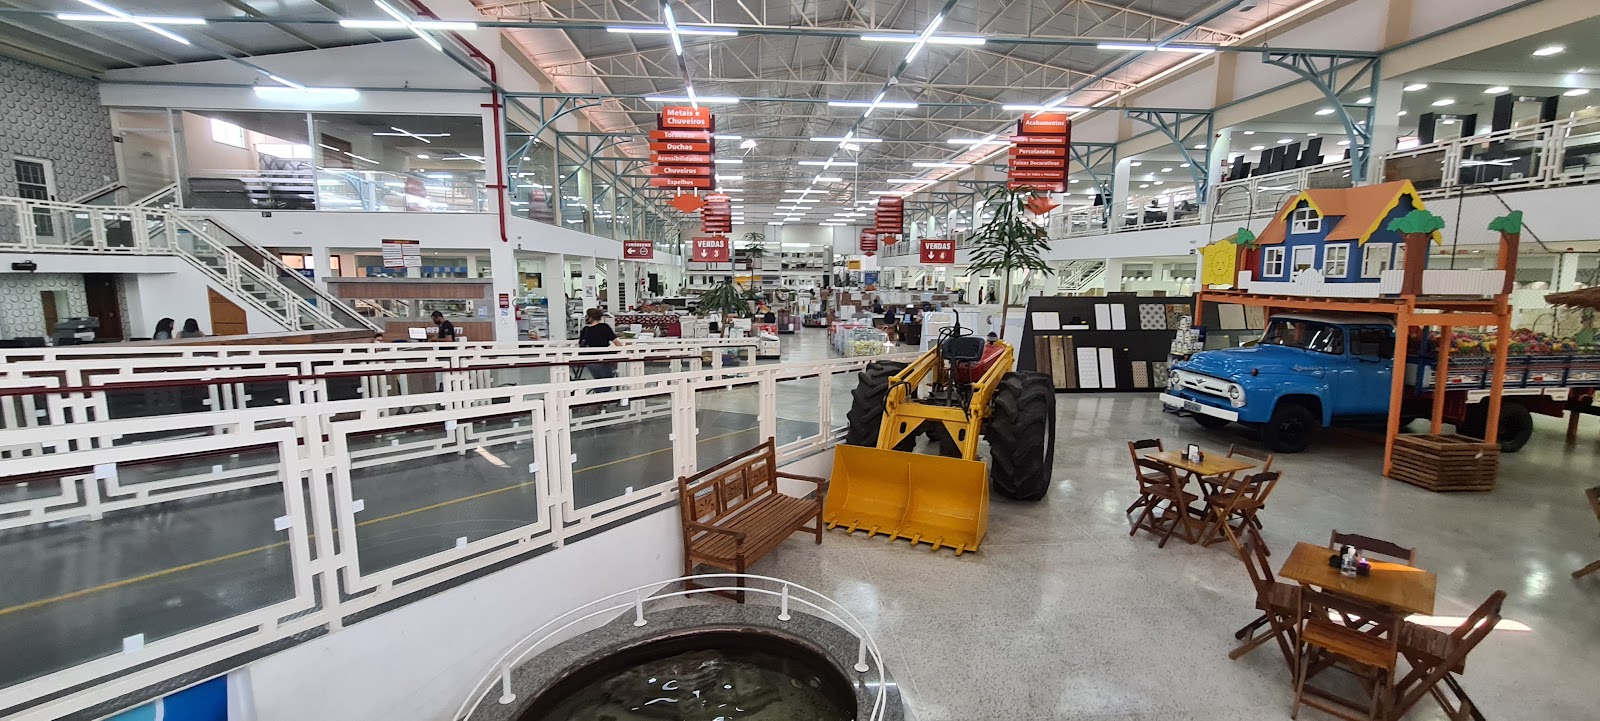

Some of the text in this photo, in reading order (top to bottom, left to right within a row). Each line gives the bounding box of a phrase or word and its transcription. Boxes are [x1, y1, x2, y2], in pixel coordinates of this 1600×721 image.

[667, 109, 693, 117] Metais
[667, 117, 706, 126] Chuveiros
[697, 240, 724, 248] VENDAS
[925, 242, 951, 250] VENDAS
[939, 252, 945, 260] 4
